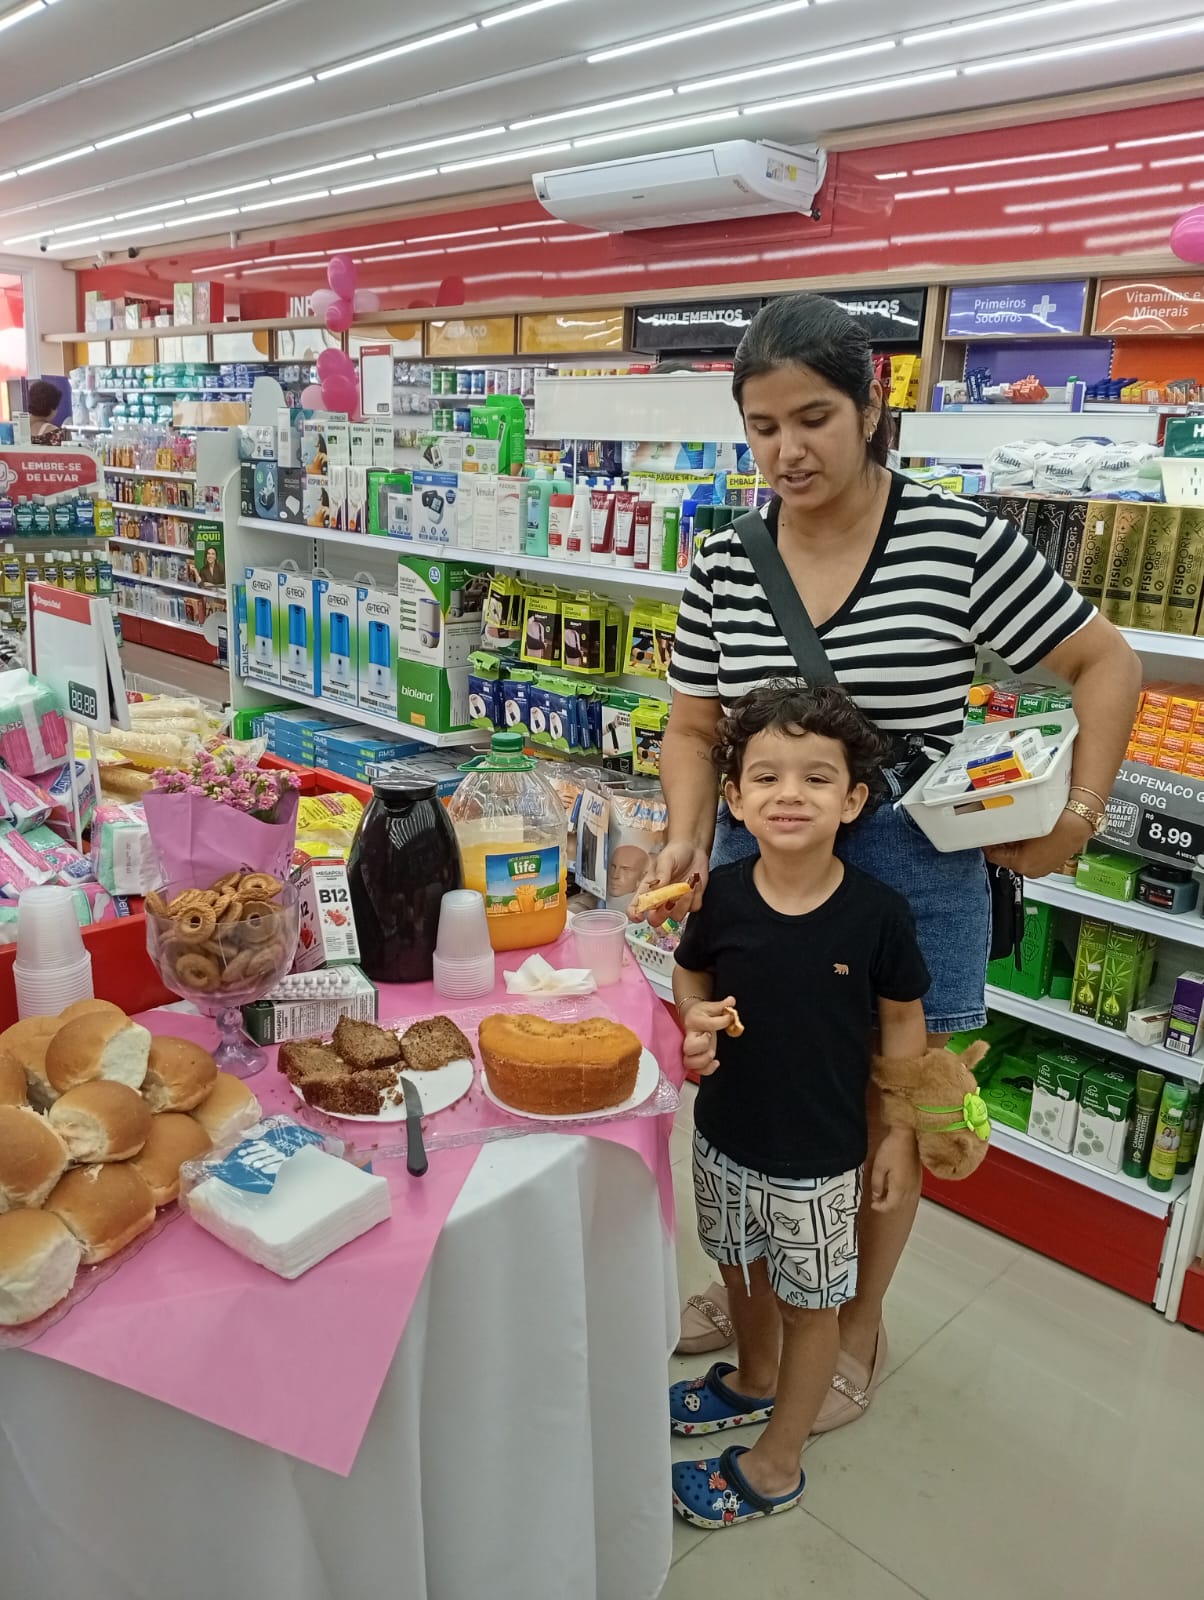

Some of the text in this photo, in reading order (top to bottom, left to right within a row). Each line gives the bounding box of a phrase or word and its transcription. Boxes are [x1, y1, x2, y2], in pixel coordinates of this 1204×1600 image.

[974, 298, 1026, 310] Primeiros
[1126, 290, 1201, 305] Vitaminas e
[1133, 304, 1189, 318] Minerais
[975, 313, 1023, 324] Socorros
[21, 461, 82, 472] LEMBRE-SE
[1045, 464, 1073, 476] Health
[26, 473, 78, 482] DE LEVAR
[1081, 529, 1097, 585] FISIOFORT
[1110, 531, 1127, 588] FISIOFORT
[1141, 533, 1159, 592] FISIOFORT
[1173, 536, 1191, 595] FISIOFORT
[366, 603, 389, 615] G-TECH
[401, 686, 434, 703] bioland
[1140, 792, 1167, 810] 60G
[1145, 812, 1155, 821] R$
[1148, 822, 1193, 849] 8,99
[513, 861, 537, 875] life
[318, 888, 349, 904] B12
